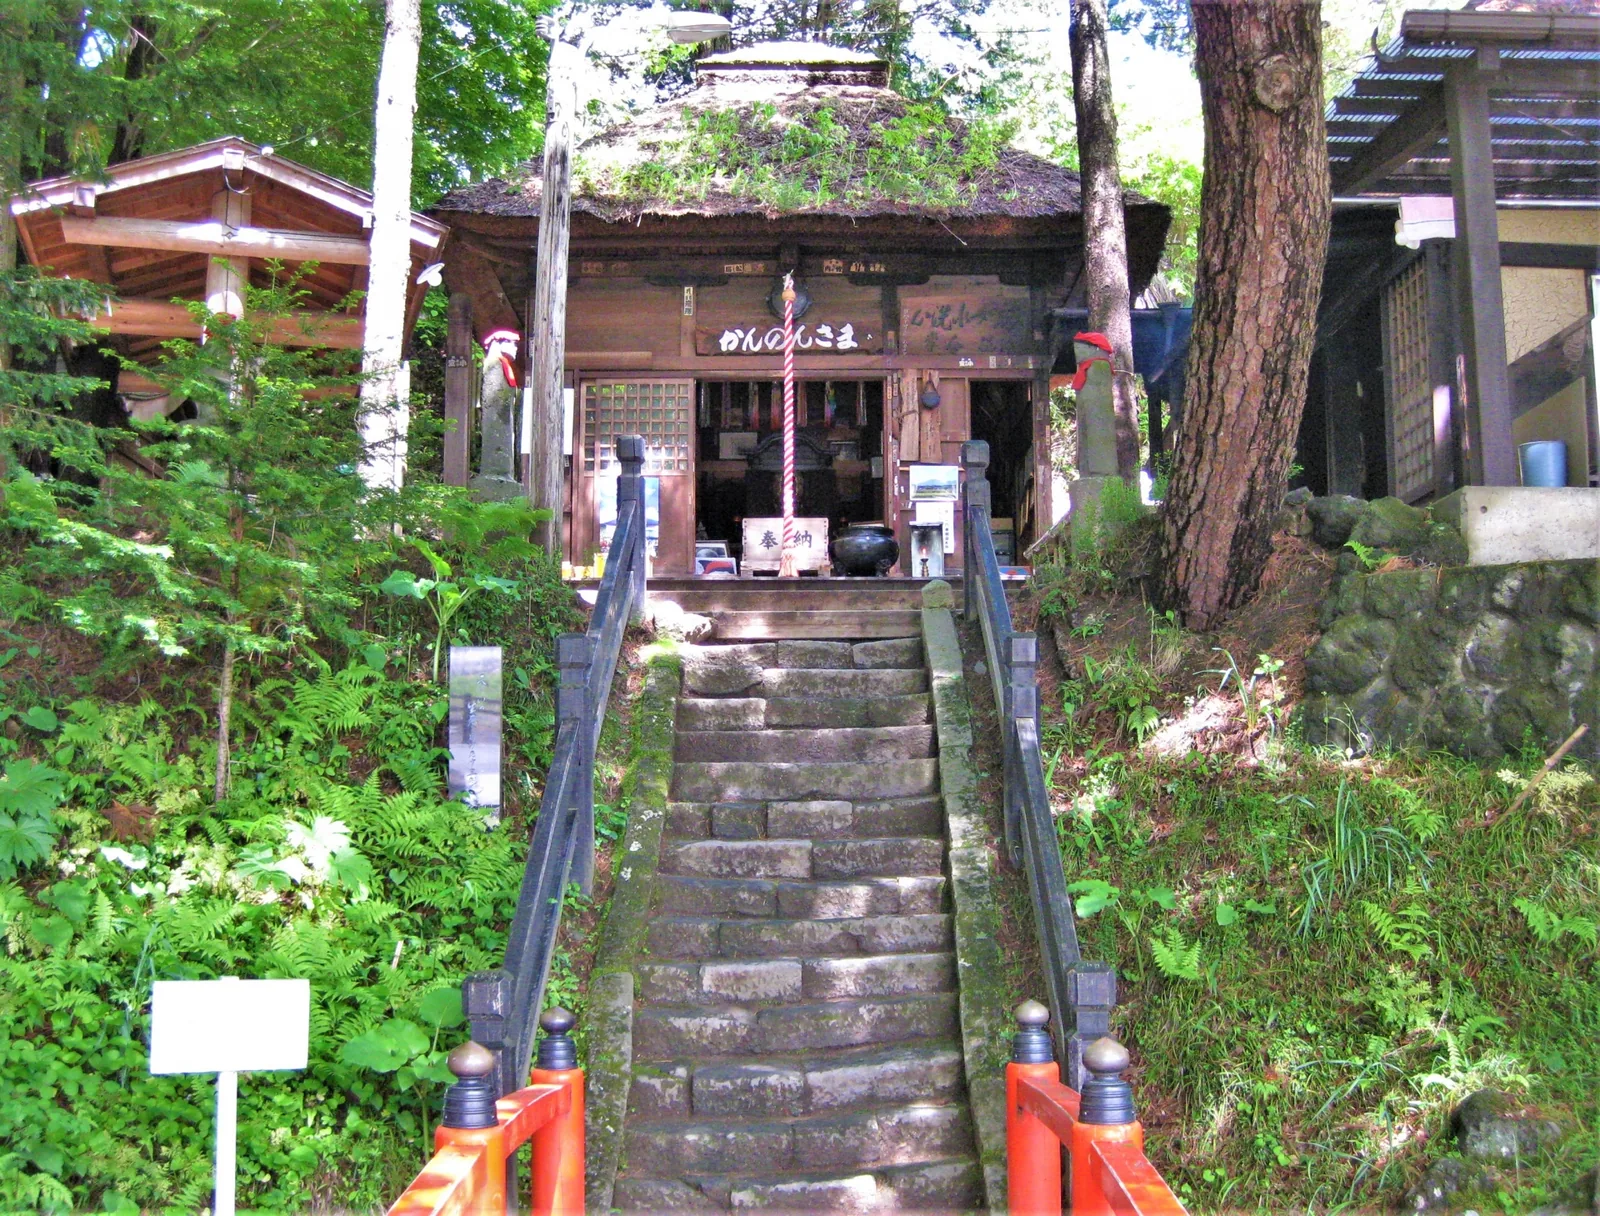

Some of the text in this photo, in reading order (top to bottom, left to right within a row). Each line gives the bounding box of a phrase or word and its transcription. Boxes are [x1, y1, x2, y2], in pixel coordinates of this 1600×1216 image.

[719, 323, 858, 352] かんのんさま
[759, 530, 813, 550] 奉納
